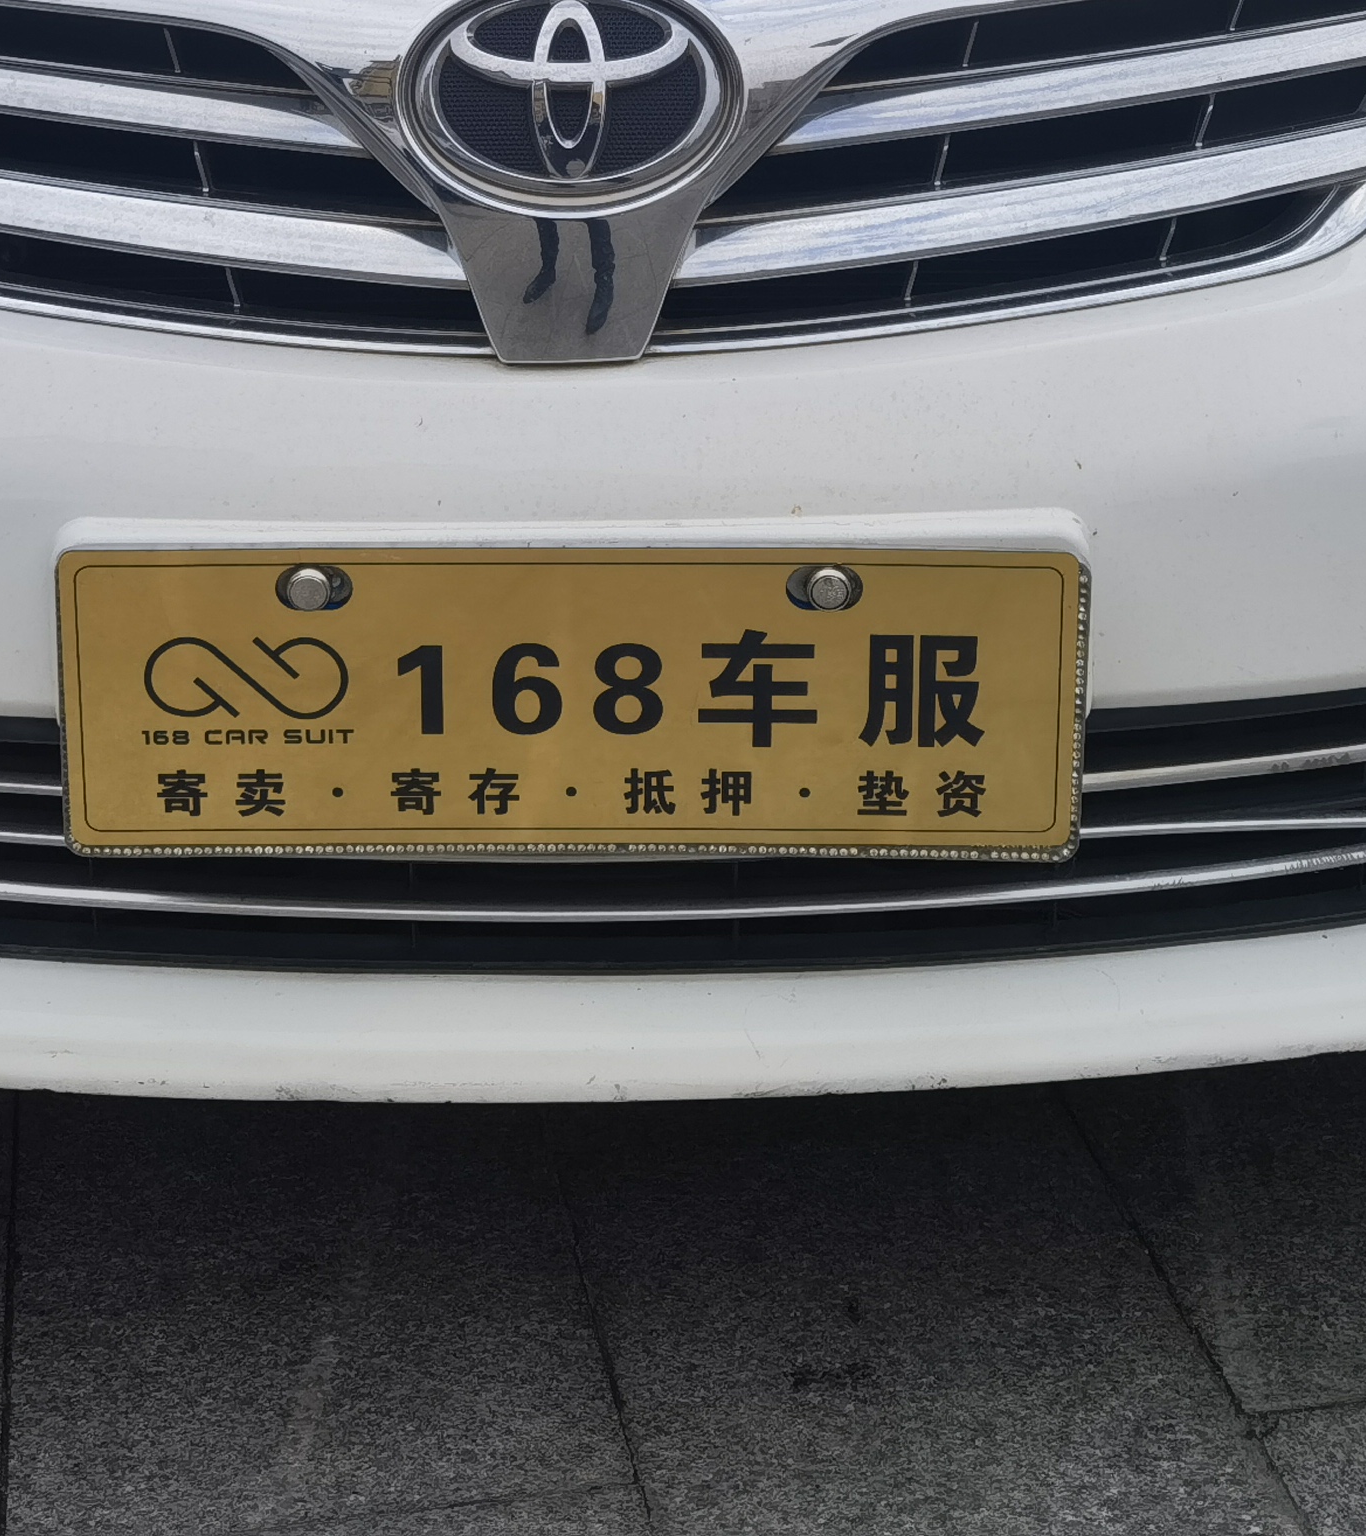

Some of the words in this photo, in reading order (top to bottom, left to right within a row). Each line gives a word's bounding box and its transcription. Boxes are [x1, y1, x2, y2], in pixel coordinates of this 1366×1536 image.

[397, 628, 987, 748] 168车服
[141, 730, 191, 746] 168
[204, 729, 269, 746] CAR
[283, 728, 355, 745] SUIT
